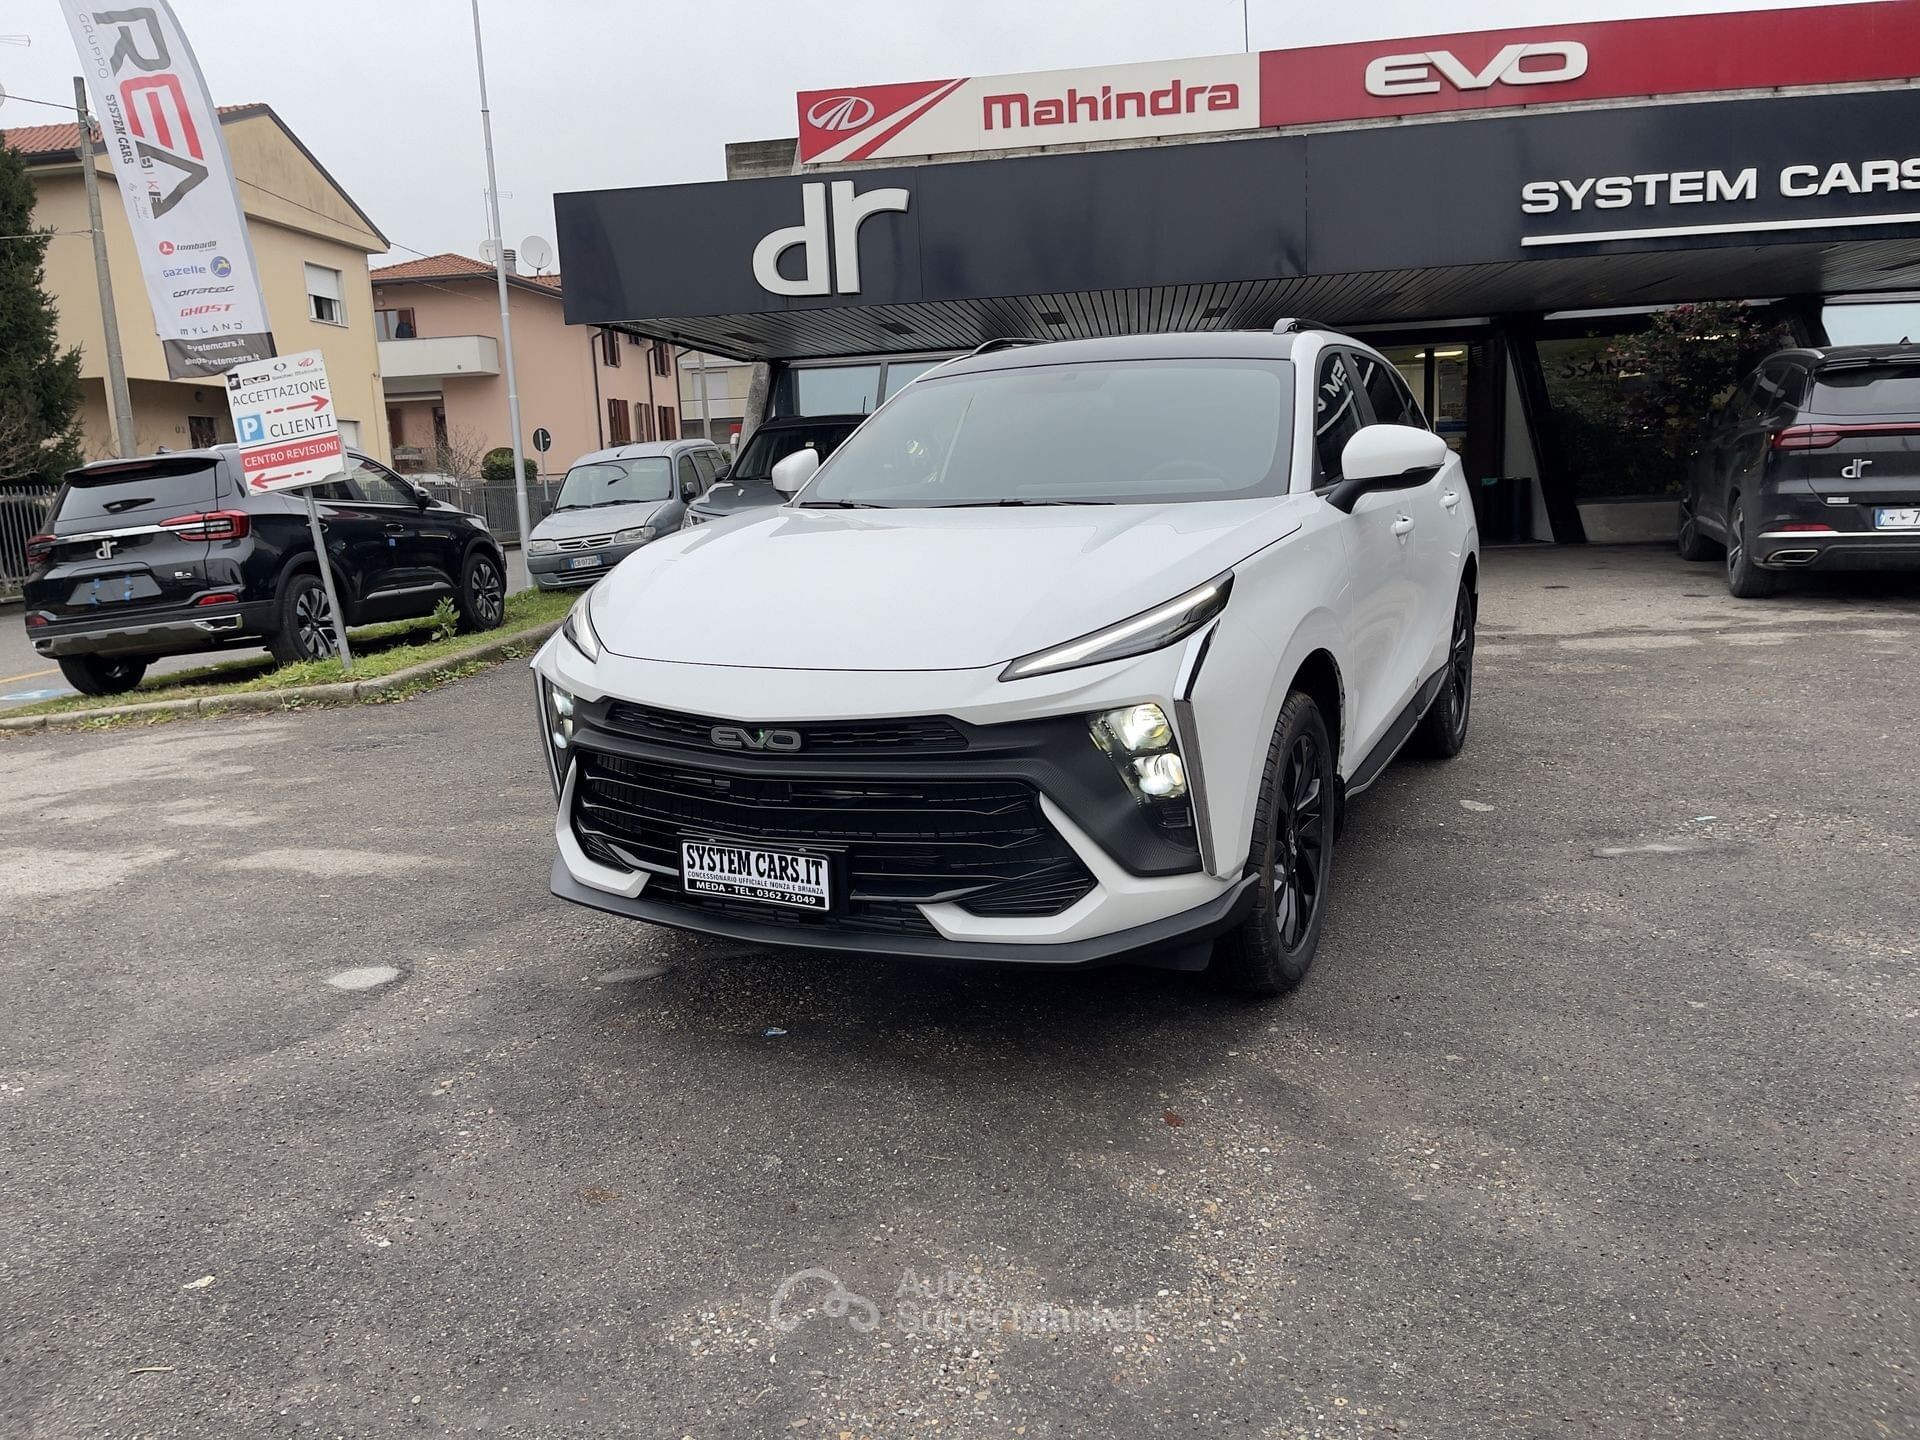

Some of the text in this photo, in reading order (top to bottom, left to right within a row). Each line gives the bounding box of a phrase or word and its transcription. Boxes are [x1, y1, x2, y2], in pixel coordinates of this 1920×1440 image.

[79, 13, 109, 79] GRUPPO
[1365, 40, 1588, 98] EVO
[92, 7, 209, 219] REA
[983, 80, 1239, 130] Mahindra
[105, 94, 134, 165] SYSTEM CARS
[1521, 167, 1757, 214] SYSTEM
[176, 240, 217, 251] lombardo
[752, 180, 910, 296] dr
[173, 285, 236, 298] corratec
[180, 303, 236, 318] GHOST
[232, 378, 327, 407] ACCETTAZIONE
[270, 414, 332, 437] CLIENTI
[244, 441, 339, 467] CENTRO REVISIONI
[1841, 458, 1873, 478] dr
[95, 540, 118, 560] dr
[710, 726, 802, 750] EVO
[687, 844, 823, 886] SYSTEM CARS.IT
[687, 870, 737, 883] CONCESSIONARIO
[738, 877, 768, 887] UFFICIALE
[797, 885, 824, 895] BRIANZA
[696, 881, 726, 892] MEDA
[733, 885, 755, 896] TEL.
[756, 889, 782, 900] 0362
[783, 892, 816, 905] 73049
